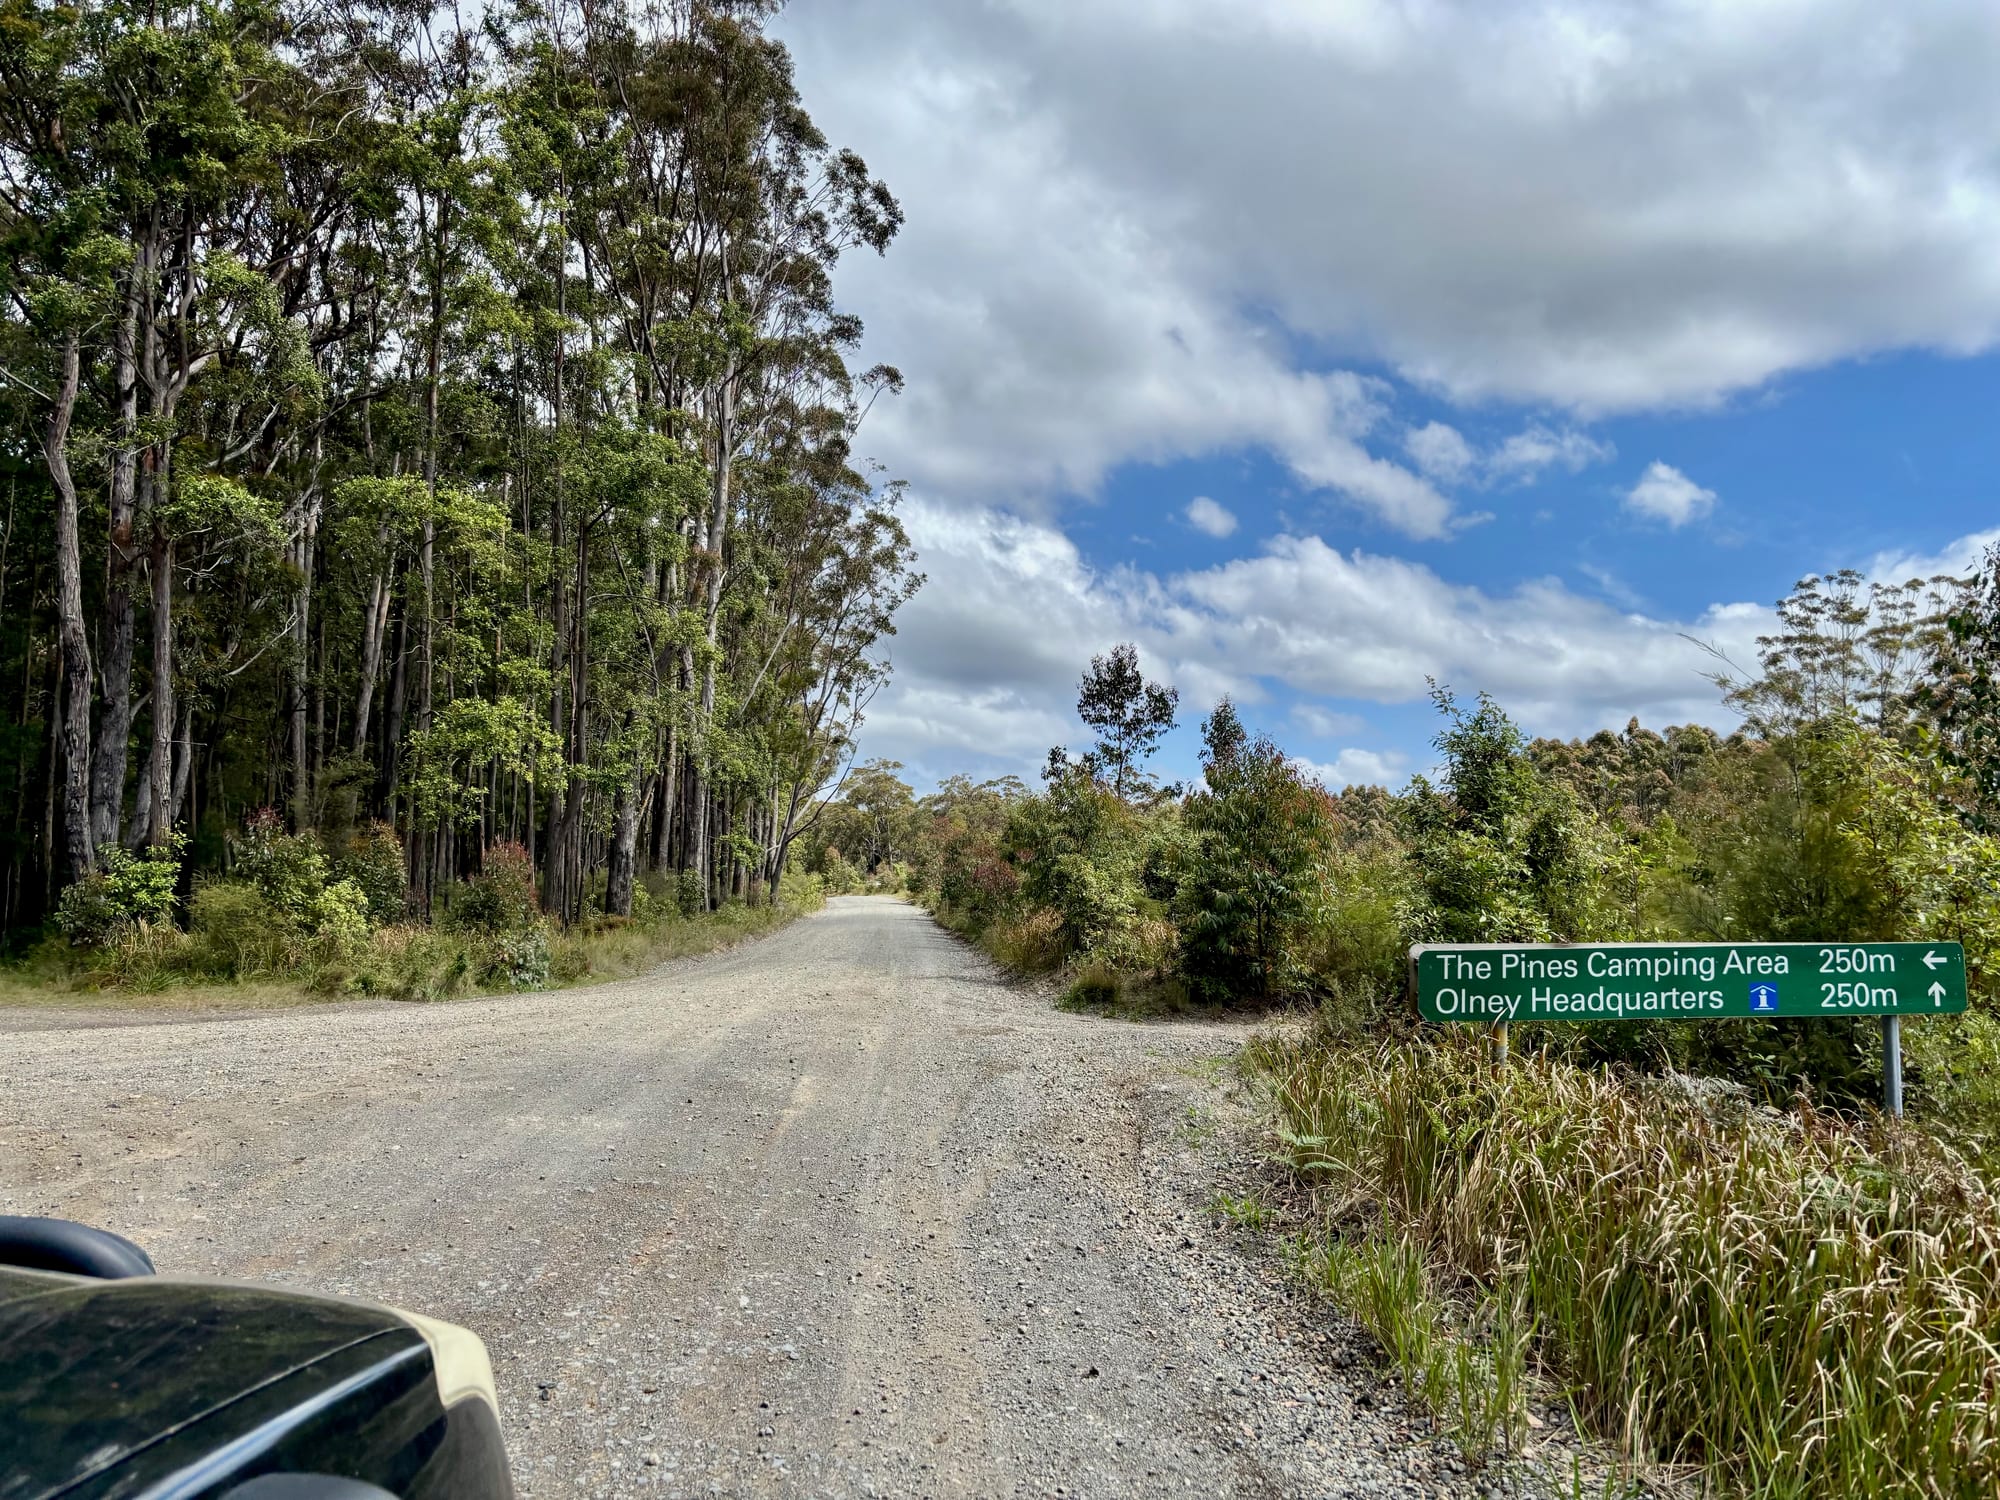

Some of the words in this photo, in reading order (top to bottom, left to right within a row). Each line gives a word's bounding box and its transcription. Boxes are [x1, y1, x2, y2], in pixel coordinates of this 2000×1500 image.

[1436, 954, 1492, 980] The
[1502, 953, 1578, 979] Pines
[1587, 950, 1715, 982] Camping
[1722, 949, 1789, 975] Area
[1818, 948, 1895, 973] 250m
[1435, 988, 1522, 1018] Olney
[1531, 985, 1724, 1017] Headquarters
[1820, 982, 1898, 1008] 250m
